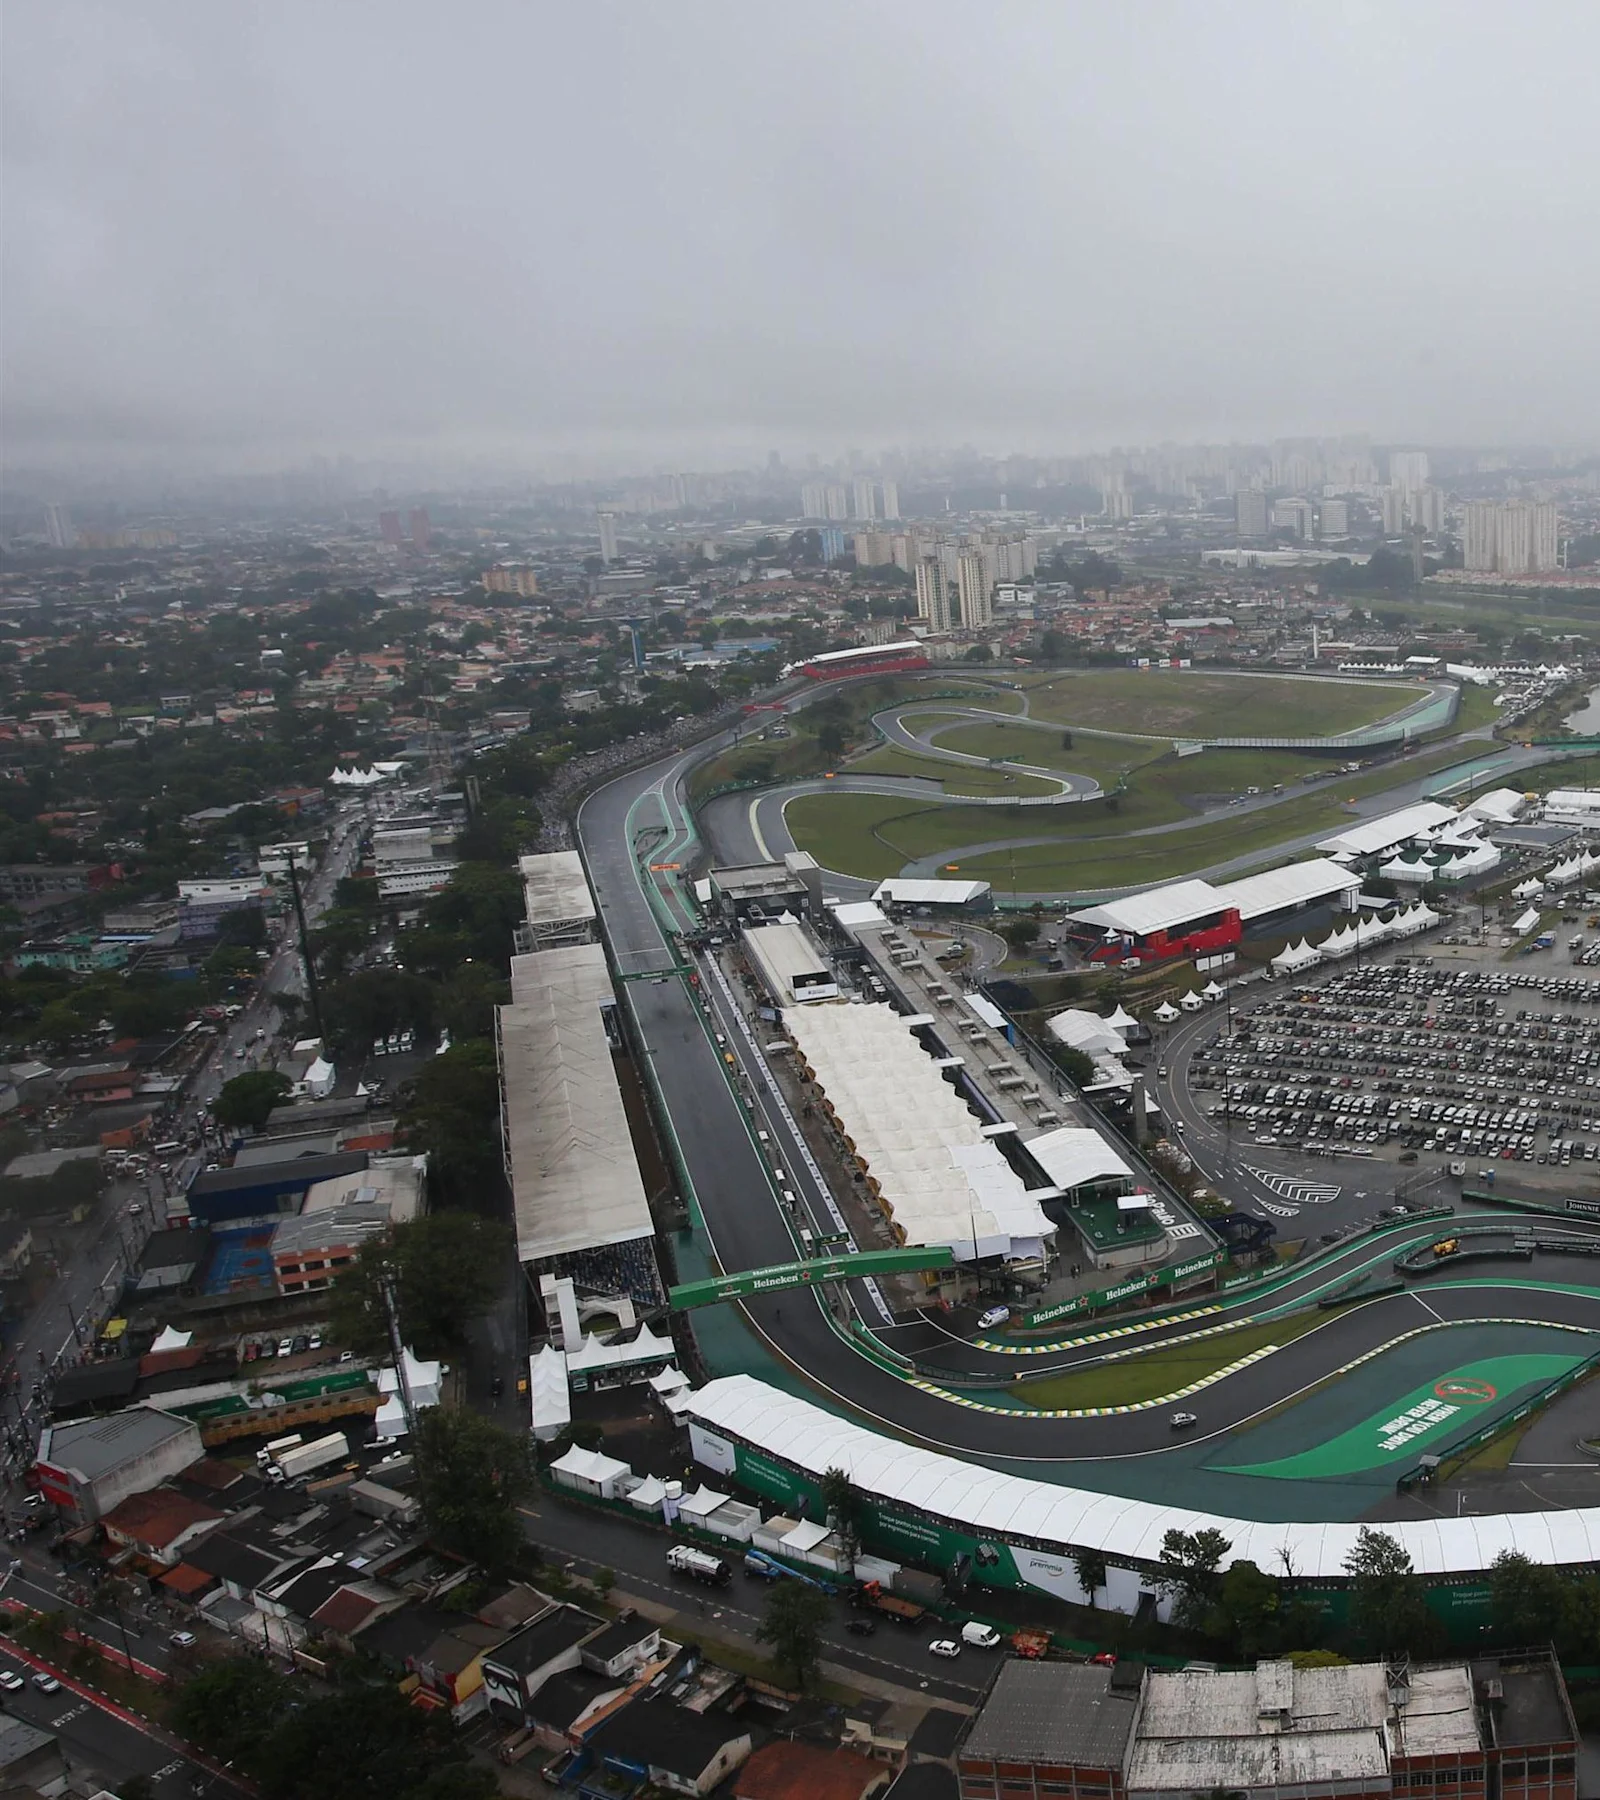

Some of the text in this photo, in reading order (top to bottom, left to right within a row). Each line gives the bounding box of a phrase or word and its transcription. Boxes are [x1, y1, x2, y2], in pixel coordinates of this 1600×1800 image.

[1569, 1202, 1599, 1212] JOHNNIE
[1174, 1256, 1214, 1278] Heineken
[753, 1274, 799, 1289] Heineken
[1106, 1278, 1147, 1300] Heineken
[1032, 1300, 1077, 1324] Heineken
[1376, 1398, 1444, 1435] NEVER DRINK
[1377, 1404, 1462, 1451] WHEN YOU DRIVE
[1030, 1560, 1063, 1573] premmia
